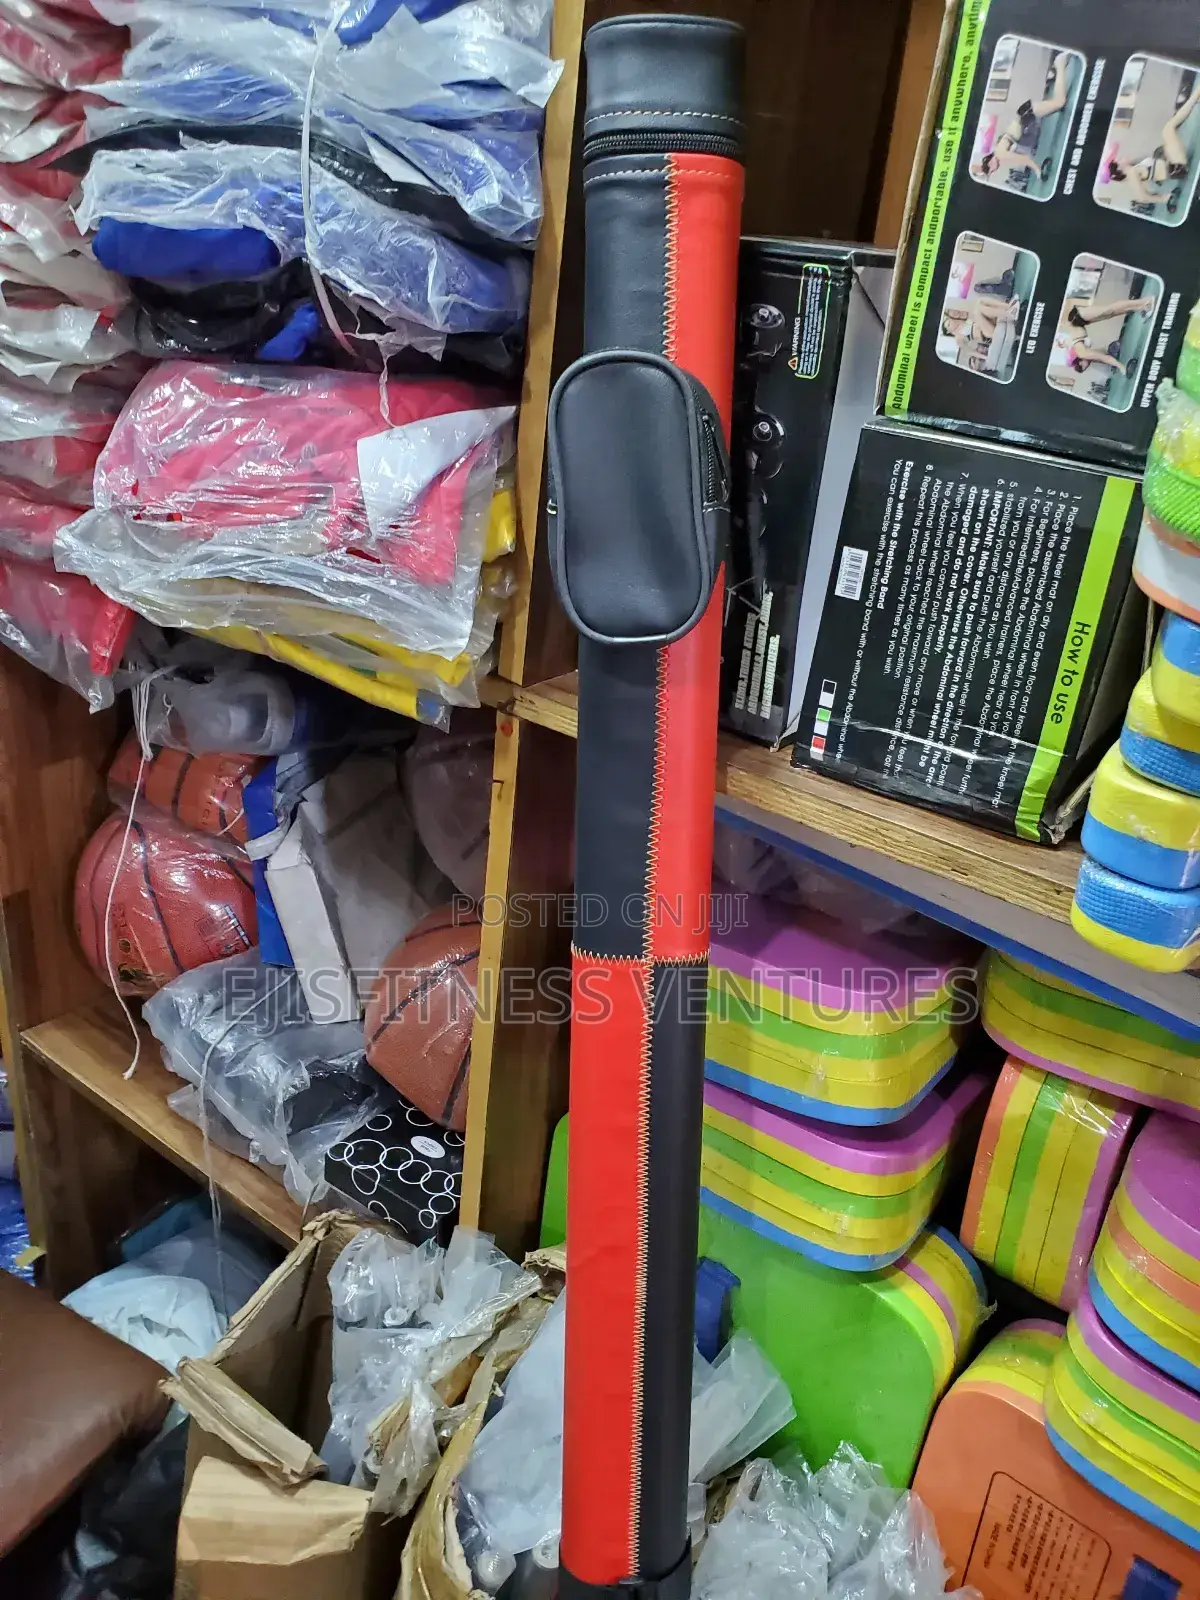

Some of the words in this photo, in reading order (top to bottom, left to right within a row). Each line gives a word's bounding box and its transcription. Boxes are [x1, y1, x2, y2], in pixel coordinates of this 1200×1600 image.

[964, 0, 981, 46] anytim
[943, 141, 954, 162] use
[916, 249, 932, 298] compact
[912, 302, 921, 311] is
[1161, 292, 1180, 330] TRAINING
[1029, 302, 1045, 337] EXERCISE
[792, 317, 800, 356] WARNING
[904, 315, 918, 349] wheel
[1154, 332, 1169, 357] WAIST
[892, 353, 910, 409] Abdominal
[1148, 360, 1161, 381] BODY
[1140, 383, 1155, 407] UPPER
[891, 458, 902, 476] You
[887, 477, 897, 494] can
[898, 460, 914, 500] Exercise
[944, 480, 955, 497] the
[915, 475, 931, 509] Repeat
[924, 478, 943, 528] Abdominal
[953, 482, 966, 509] When
[880, 496, 895, 532] exercise
[893, 501, 905, 521] with
[958, 485, 978, 534] damaged
[976, 488, 991, 520] shown
[997, 492, 1015, 536] stabilized
[1014, 495, 1028, 518] from
[1028, 498, 1040, 513] For
[1041, 500, 1053, 516] For
[913, 510, 924, 526] this
[933, 498, 951, 548] Abdominal
[947, 510, 958, 527] you
[982, 490, 1003, 548] IMPORTANT:
[1008, 519, 1020, 537] you
[1051, 503, 1066, 530] Place
[1064, 505, 1079, 534] Place
[890, 522, 901, 538] the
[945, 530, 956, 547] feel
[1028, 517, 1049, 565] Beginners,
[1047, 532, 1058, 548] the
[877, 534, 887, 551] with
[904, 527, 918, 562] process
[919, 530, 932, 557] wheel
[955, 536, 967, 556] and
[968, 536, 980, 553] the
[1059, 535, 1071, 551] the
[873, 552, 883, 567] the
[879, 539, 897, 585] Stretching
[927, 549, 940, 576] wheel
[939, 548, 950, 565] you
[975, 550, 989, 578] Make
[987, 537, 1004, 573] yourself
[1001, 550, 1013, 568] any
[1052, 553, 1067, 578] kneel
[903, 564, 911, 575] as
[914, 558, 926, 581] back
[948, 572, 959, 588] not
[961, 554, 974, 585] cover.
[1003, 515, 1036, 622] Intermediate/Advanced
[1020, 566, 1036, 594] place
[1034, 550, 1054, 601] assembled
[864, 567, 880, 607] stretching
[896, 576, 908, 601] many
[911, 582, 921, 592] to
[934, 567, 948, 599] cannot
[970, 579, 981, 599] sure
[984, 574, 996, 593] and
[993, 570, 1010, 609] distance
[1047, 579, 1060, 599] mat
[876, 585, 888, 609] Band
[906, 593, 916, 611] your
[919, 577, 934, 615] reached
[943, 590, 955, 613] work
[978, 594, 991, 616] push
[1018, 596, 1029, 611] the
[861, 608, 872, 631] band
[893, 603, 905, 626] times
[927, 600, 940, 622] push
[950, 587, 968, 633] Otherwise
[1038, 614, 1051, 629] dry
[890, 627, 897, 638] as
[899, 613, 914, 645] original
[915, 616, 925, 631] the
[932, 614, 950, 655] properly.
[961, 612, 975, 636] push
[975, 618, 986, 632] the
[984, 622, 996, 639] you
[1021, 601, 1041, 650] Abdominal
[857, 631, 867, 648] with
[885, 639, 895, 655] you
[921, 623, 935, 655] forward
[947, 634, 957, 650] the
[993, 623, 1010, 657] trainers,
[1006, 612, 1025, 661] Abdominal
[1034, 630, 1047, 649] and
[1066, 621, 1092, 665] How
[855, 649, 862, 658] or
[905, 632, 922, 674] maximum
[954, 637, 969, 672] forward
[964, 633, 982, 680] Abdominal
[980, 641, 993, 661] wish.
[1028, 650, 1040, 672] even
[850, 659, 862, 687] without
[882, 656, 893, 676] wish.
[891, 646, 907, 681] position.
[916, 656, 926, 672] any
[986, 659, 1001, 685] place
[999, 661, 1013, 688] wheel
[1014, 651, 1028, 678] wheel
[912, 673, 922, 695] more
[935, 651, 953, 701] Abdominal
[1023, 674, 1036, 694] floor
[1060, 669, 1080, 686] to
[846, 687, 856, 701] the
[895, 675, 912, 715] resistance
[910, 697, 917, 706] or
[947, 683, 958, 699] the
[957, 681, 971, 707] wheel
[984, 686, 994, 701] the
[994, 689, 1004, 708] near
[1007, 689, 1018, 709] front
[928, 702, 941, 728] wheel
[1018, 695, 1030, 713] and
[1049, 692, 1071, 725] use
[904, 707, 916, 729] when
[936, 700, 954, 739] direction
[951, 717, 961, 730] the
[1011, 714, 1025, 737] kneel
[883, 753, 893, 767] roll
[896, 746, 907, 762] feel
[929, 750, 940, 765] the
[996, 765, 1010, 790] kneel
